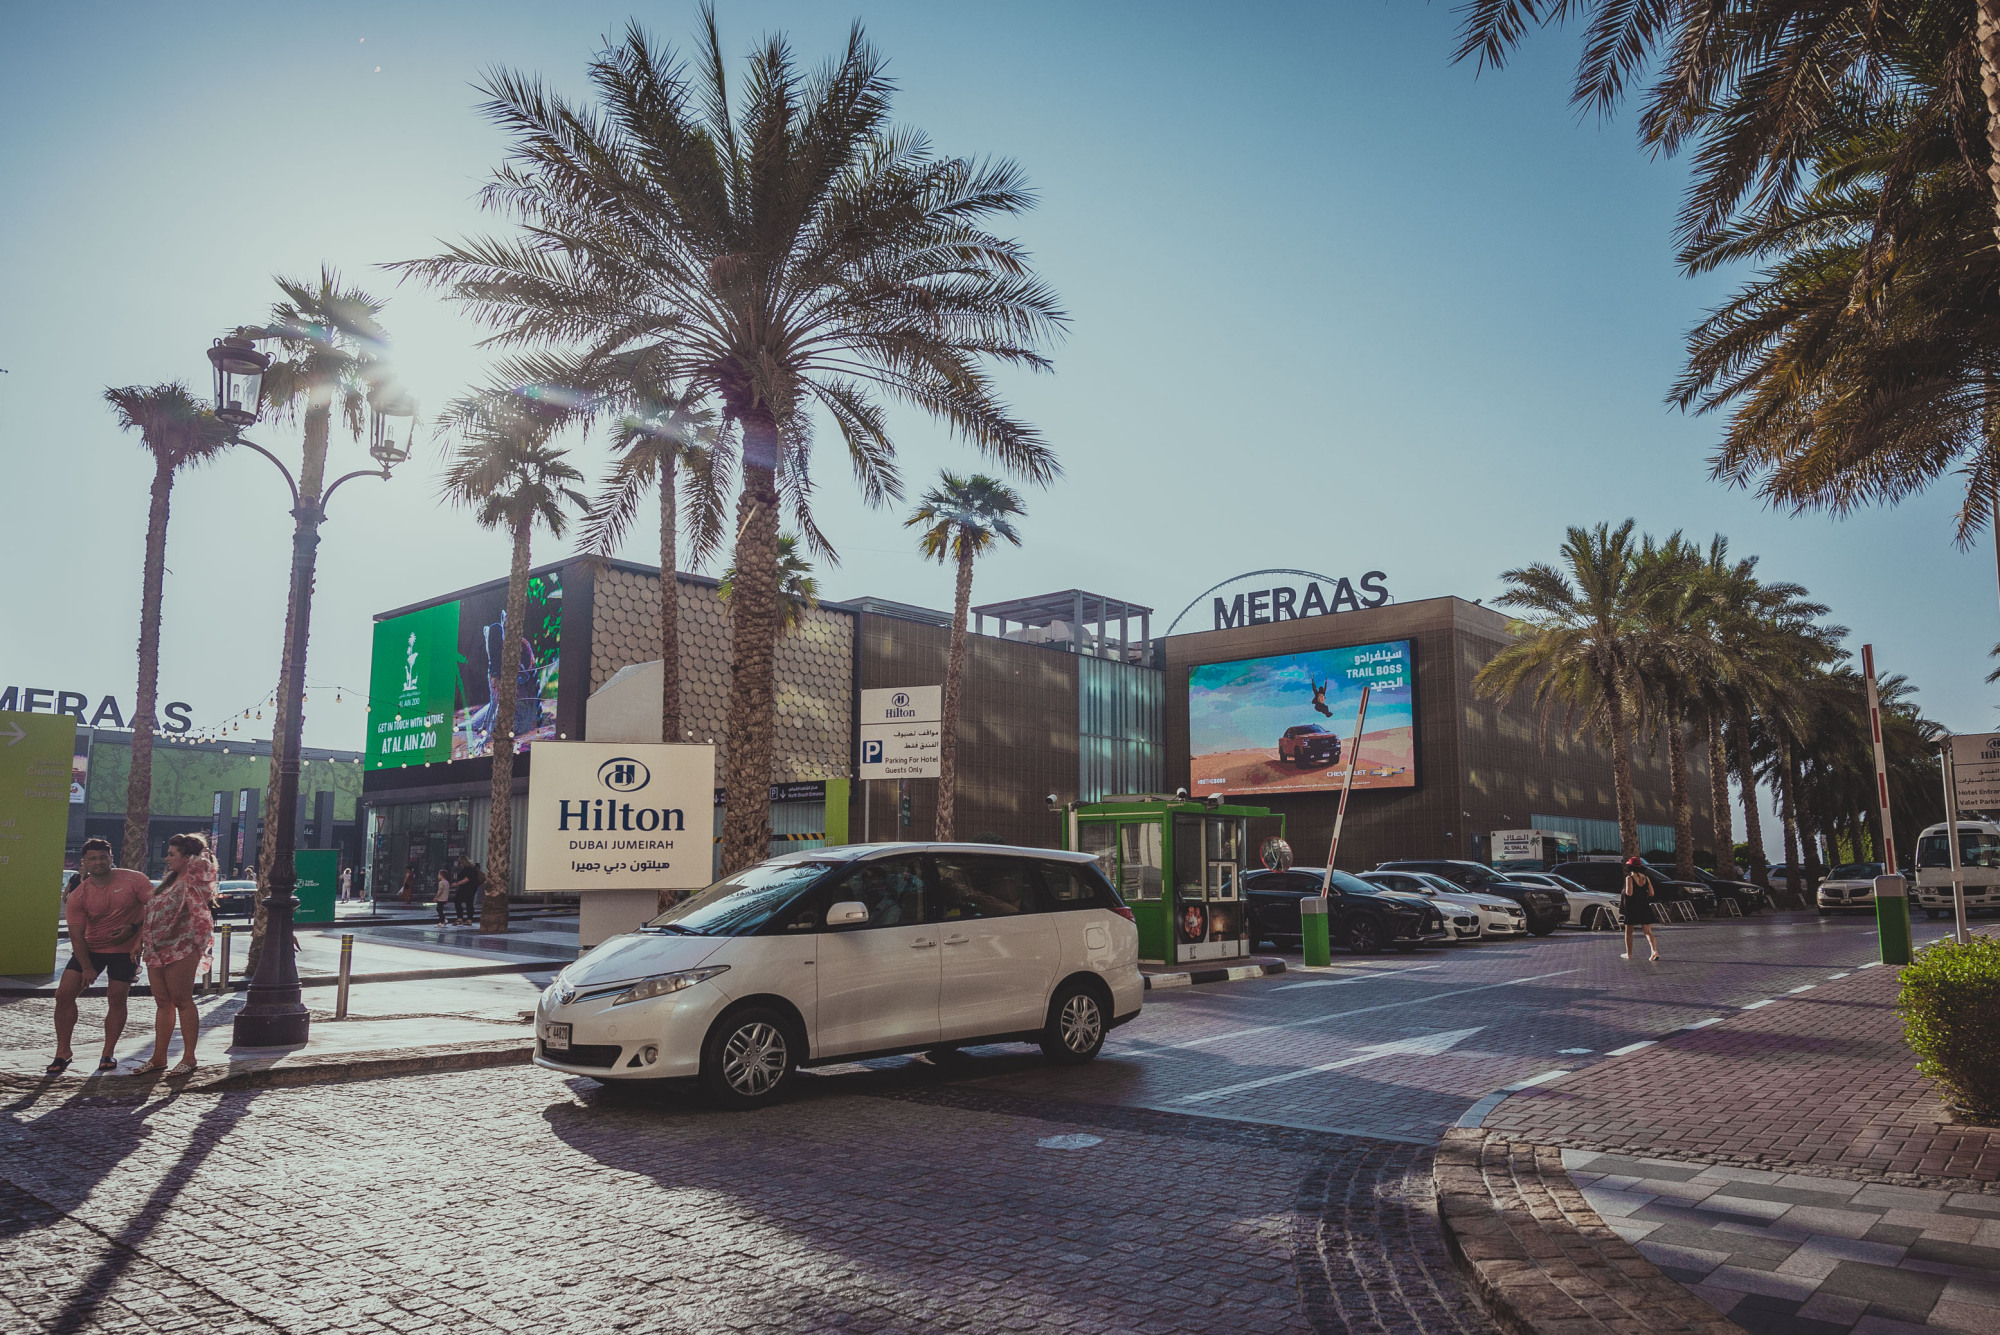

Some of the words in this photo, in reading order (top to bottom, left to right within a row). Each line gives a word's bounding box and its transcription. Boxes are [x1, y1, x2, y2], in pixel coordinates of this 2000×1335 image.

[1213, 570, 1389, 631] MERAAS
[1354, 650, 1402, 665] سيلفرادو
[1346, 667, 1374, 679] TRAIL
[1376, 664, 1402, 676] BOSS
[1370, 677, 1403, 692] الجديد
[886, 708, 915, 718] Hilton
[378, 723, 387, 733] GET
[387, 722, 394, 732] IN
[394, 719, 409, 730] TOUCH
[410, 716, 423, 728] WITH
[382, 737, 392, 754] AT
[392, 736, 402, 752] AL
[404, 733, 419, 751] AIN
[420, 731, 437, 749] ZOO
[920, 742, 938, 750] الفندق
[908, 766, 922, 774] Only
[1326, 770, 1367, 778] CHEVLET
[558, 799, 685, 831] Hilton
[569, 841, 607, 849] DUBAI
[612, 841, 673, 849] JUMEIRAH
[571, 860, 600, 873] جميرا
[604, 862, 627, 874] دبي
[630, 860, 670, 872] هيلتون
